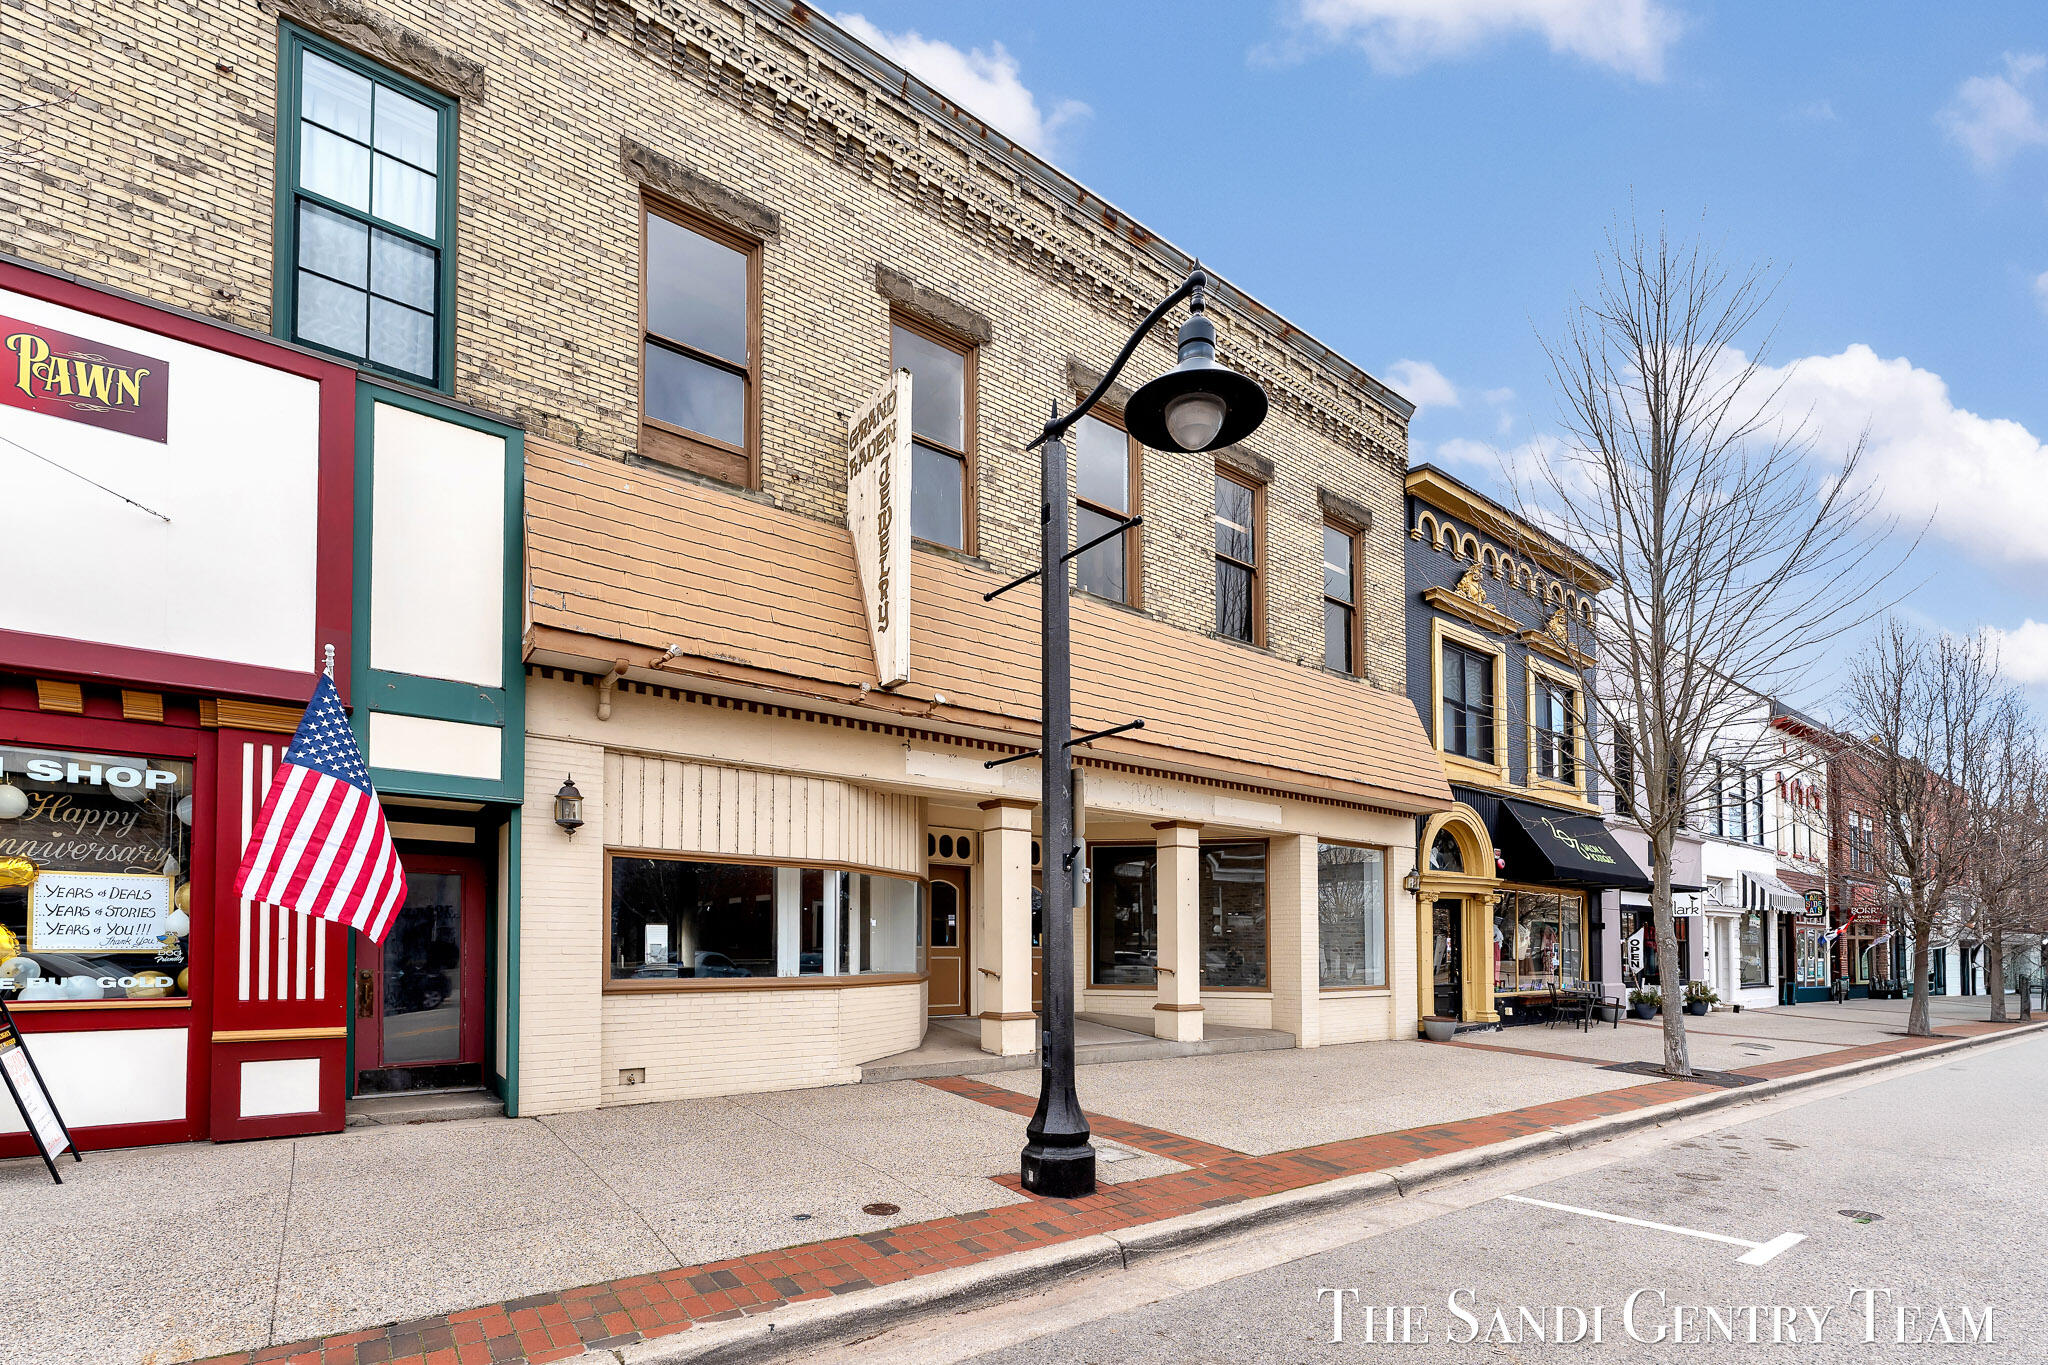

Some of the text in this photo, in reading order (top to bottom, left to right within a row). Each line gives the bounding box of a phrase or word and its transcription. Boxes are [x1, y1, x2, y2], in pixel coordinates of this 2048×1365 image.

[5, 332, 151, 407] PAWN
[849, 390, 897, 452] GRAND
[877, 452, 893, 634] JEWELRY
[26, 759, 178, 790] SHOP
[24, 792, 140, 838] Happy
[97, 889, 107, 898] of
[109, 886, 152, 900] DEALS
[94, 908, 103, 916] of
[105, 904, 156, 919] STORIES
[1673, 900, 1699, 915] lark
[93, 926, 103, 935] of
[106, 922, 152, 936] YOU!!!
[99, 936, 132, 947] Thank
[1629, 939, 1640, 968] OPEN
[96, 976, 174, 988] GOLD
